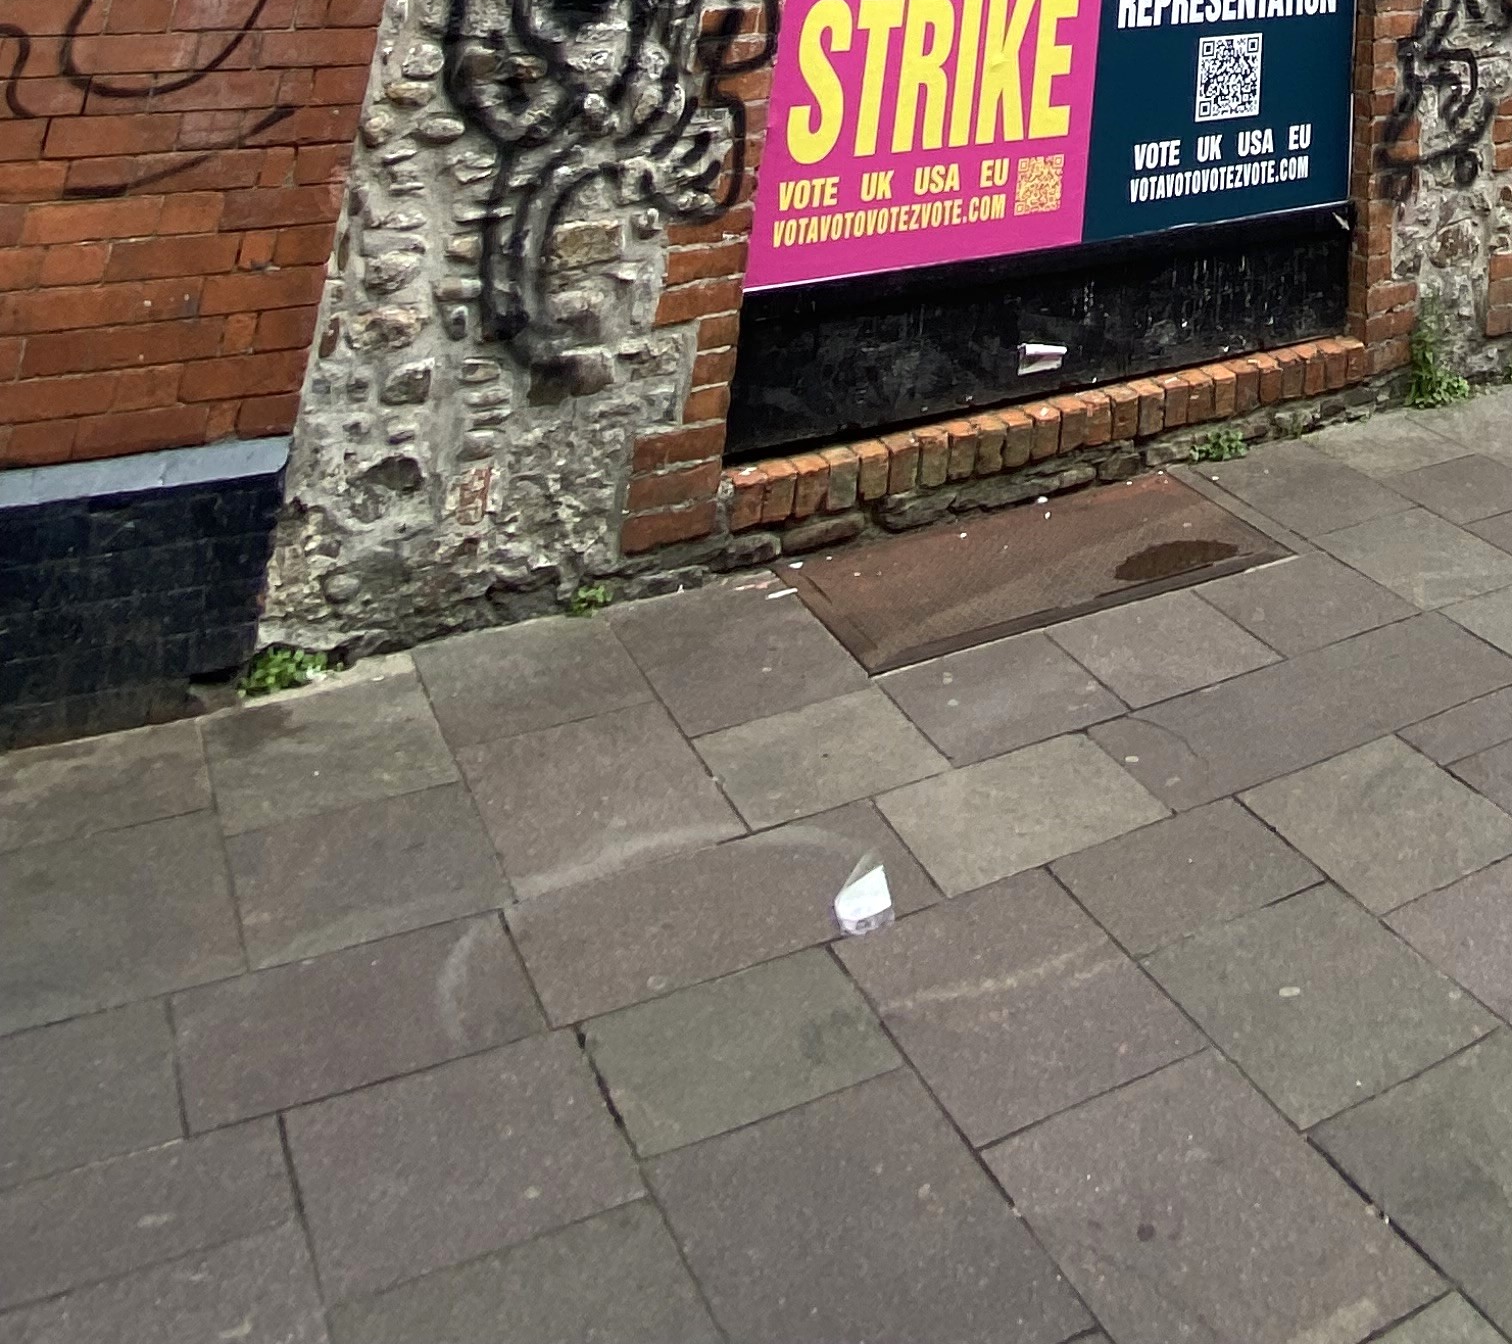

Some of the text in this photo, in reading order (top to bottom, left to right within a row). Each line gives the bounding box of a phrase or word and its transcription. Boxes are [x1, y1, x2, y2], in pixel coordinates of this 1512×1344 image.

[1134, 123, 1312, 171] VOTE UK USA EU
[778, 158, 1010, 211] VOTE UK USA EU
[1130, 156, 1309, 203] VOTAVOTOVOTEZVOTE.COM
[772, 193, 1006, 248] VOTAVOTOVOTEZVOTE.COM
